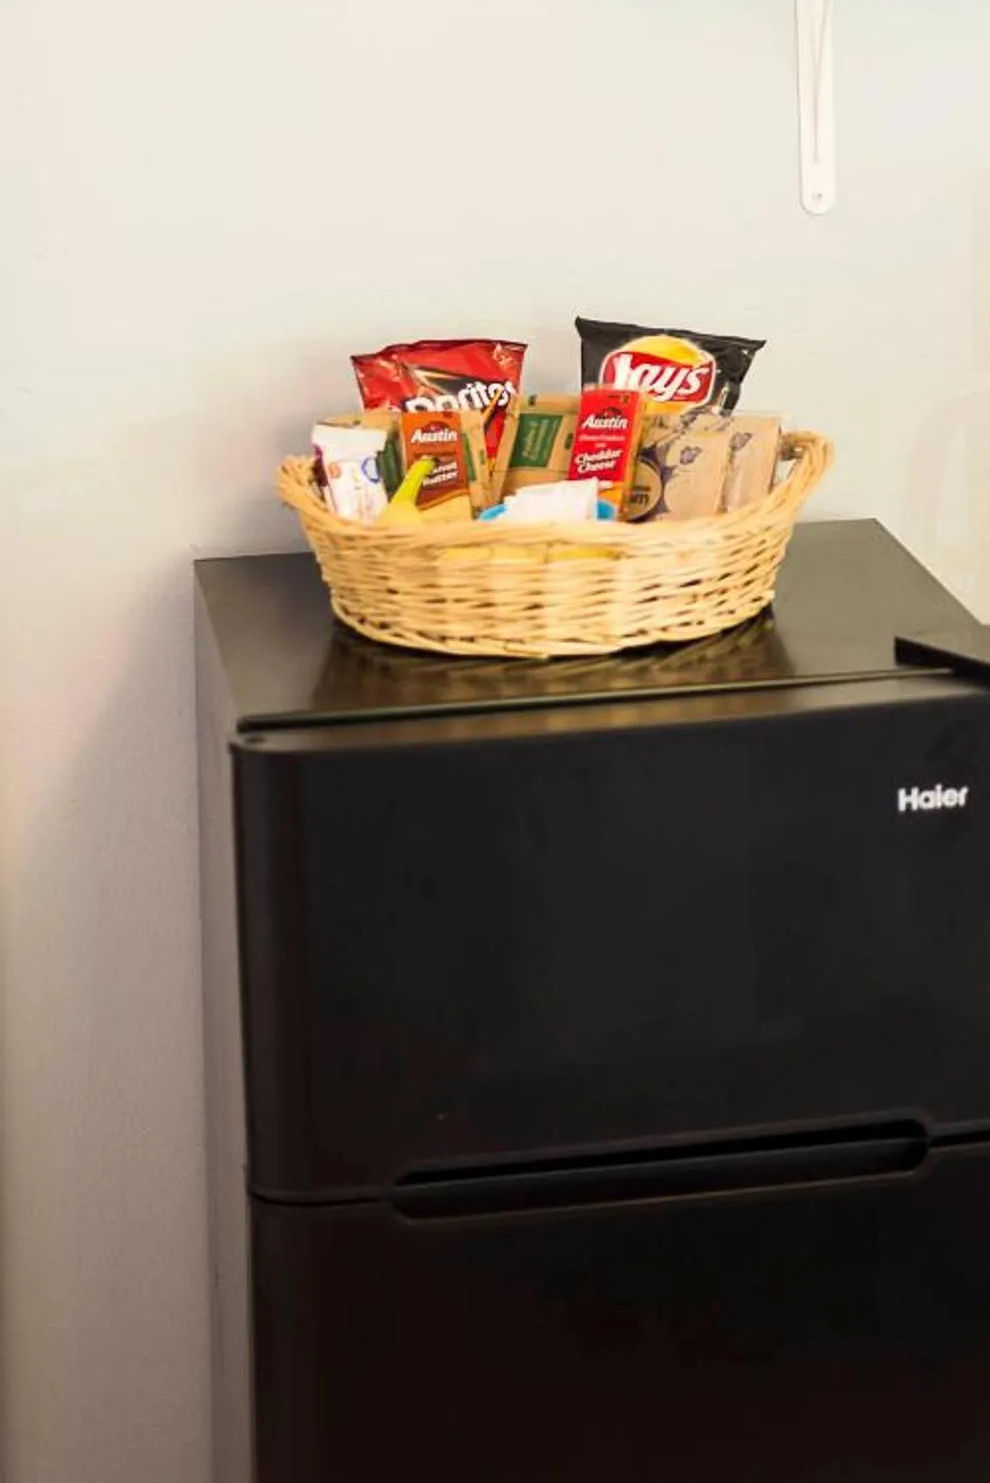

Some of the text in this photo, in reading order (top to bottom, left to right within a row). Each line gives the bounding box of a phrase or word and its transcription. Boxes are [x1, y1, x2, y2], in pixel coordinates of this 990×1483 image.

[582, 414, 628, 429] Austin
[410, 428, 458, 443] Austin
[897, 784, 969, 812] Haier
